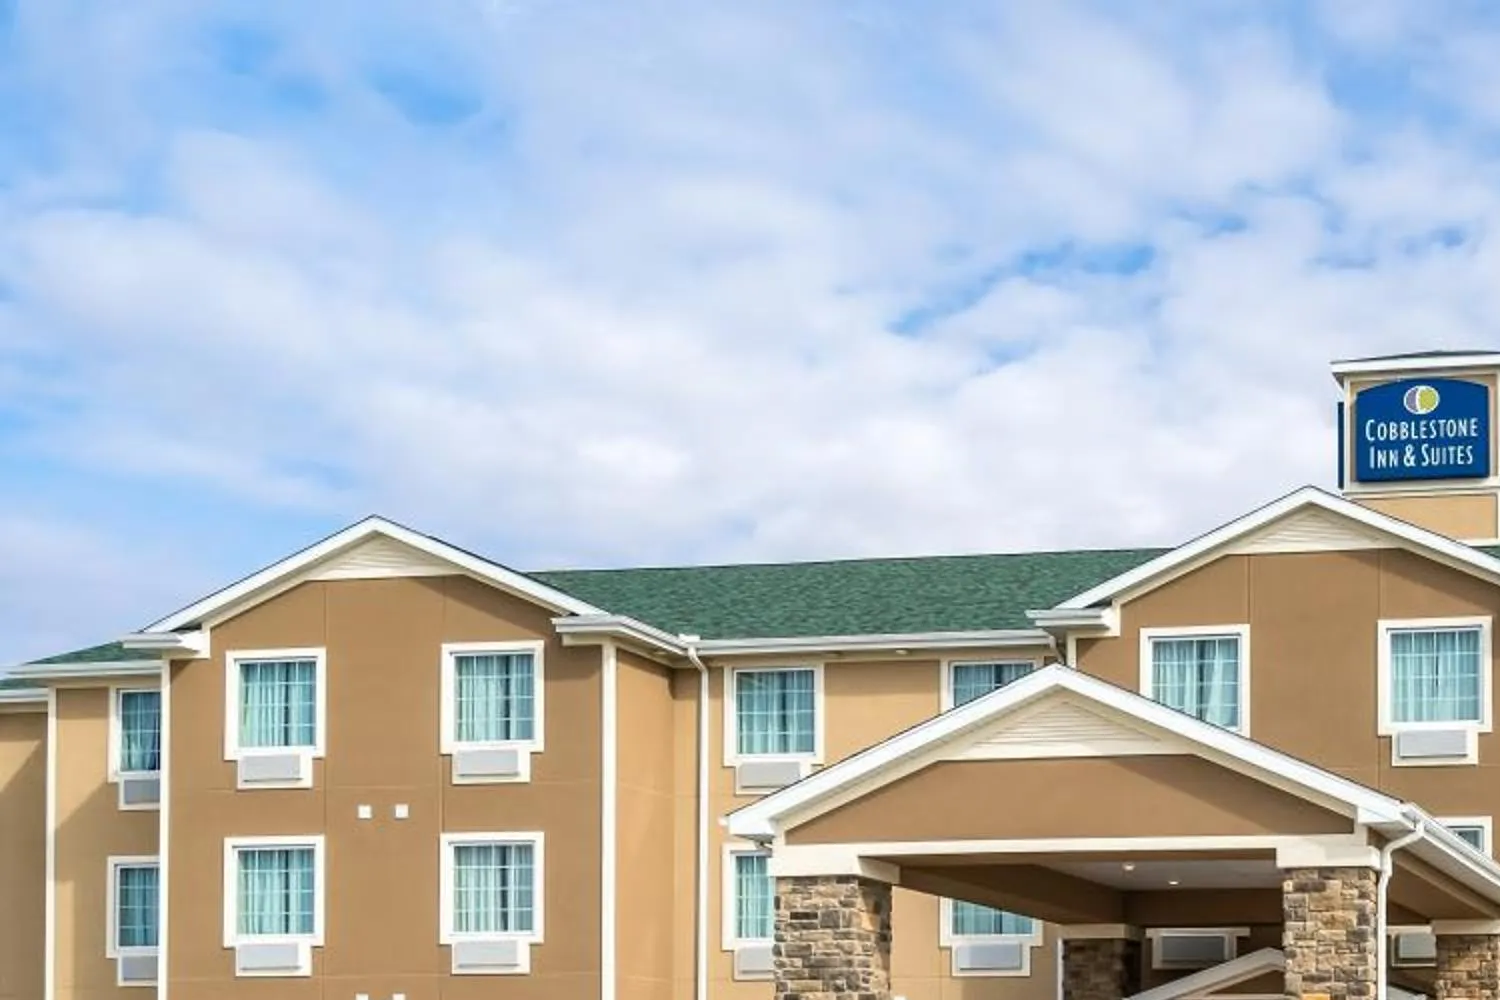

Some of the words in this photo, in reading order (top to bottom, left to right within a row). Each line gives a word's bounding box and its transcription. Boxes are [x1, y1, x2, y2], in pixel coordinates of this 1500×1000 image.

[1365, 418, 1478, 441] COBBLESTONE
[1369, 446, 1399, 469] INN
[1403, 444, 1416, 467] &
[1421, 443, 1473, 467] SUITES
